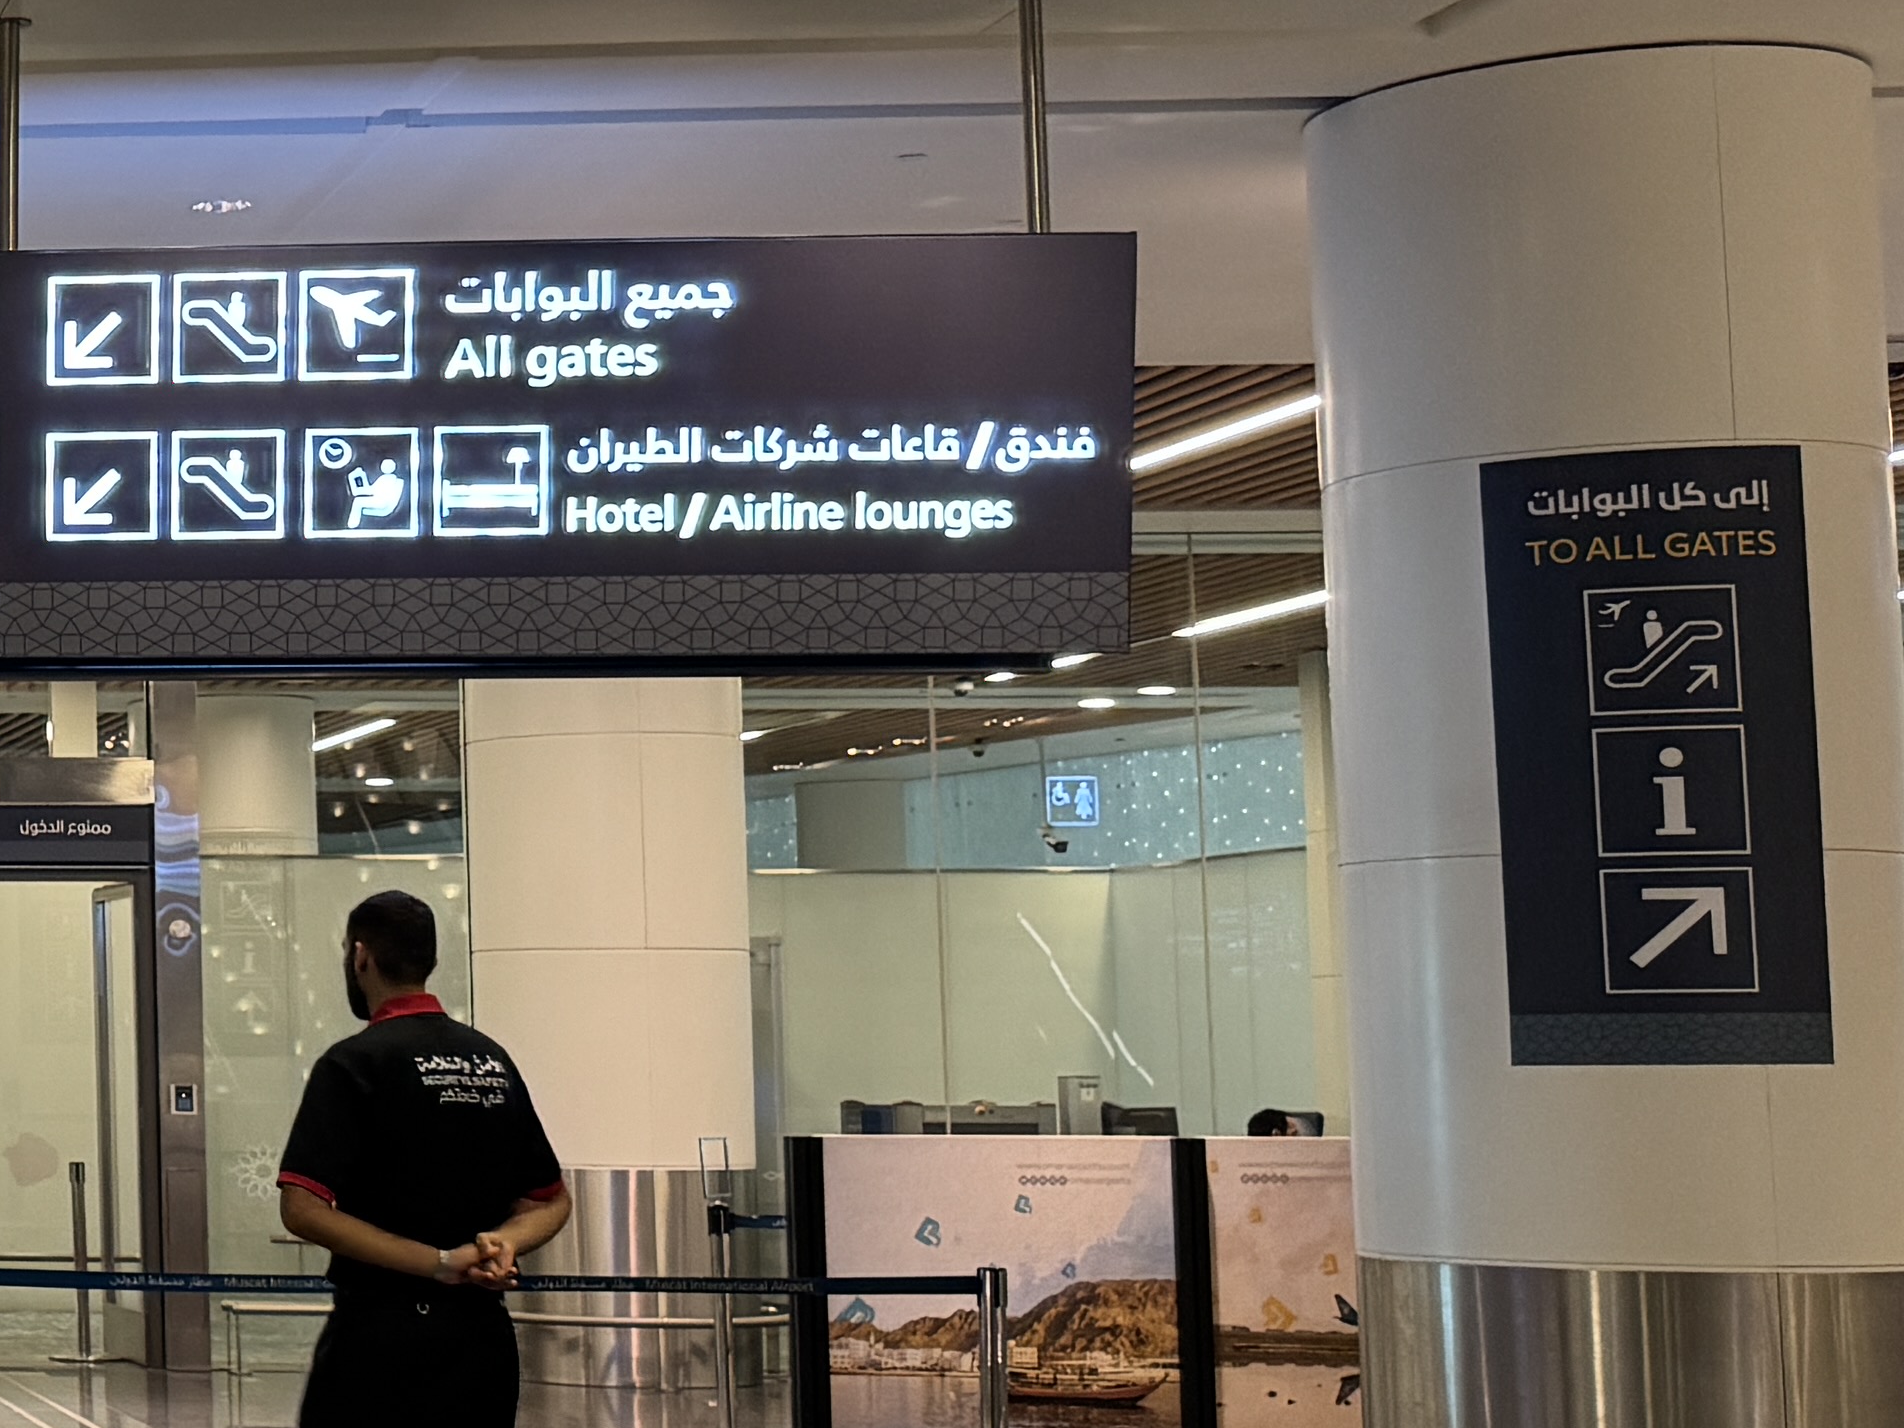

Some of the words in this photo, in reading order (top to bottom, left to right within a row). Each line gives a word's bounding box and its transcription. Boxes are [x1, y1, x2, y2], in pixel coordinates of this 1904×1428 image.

[443, 269, 614, 322] البوابات
[622, 280, 735, 330] جميع
[443, 333, 513, 380] All
[524, 337, 660, 388] gates
[565, 425, 703, 474] الطيران
[709, 422, 840, 471] شركات
[854, 490, 1015, 539] lounges
[1526, 482, 1651, 521] البوابات
[1657, 481, 1708, 511] كل
[1712, 478, 1771, 512] إلى
[1524, 538, 1579, 567] TO
[1584, 533, 1657, 563] ALL
[1663, 529, 1778, 559] GATES
[18, 818, 65, 836] الدخول
[66, 819, 112, 836] ممنوع
